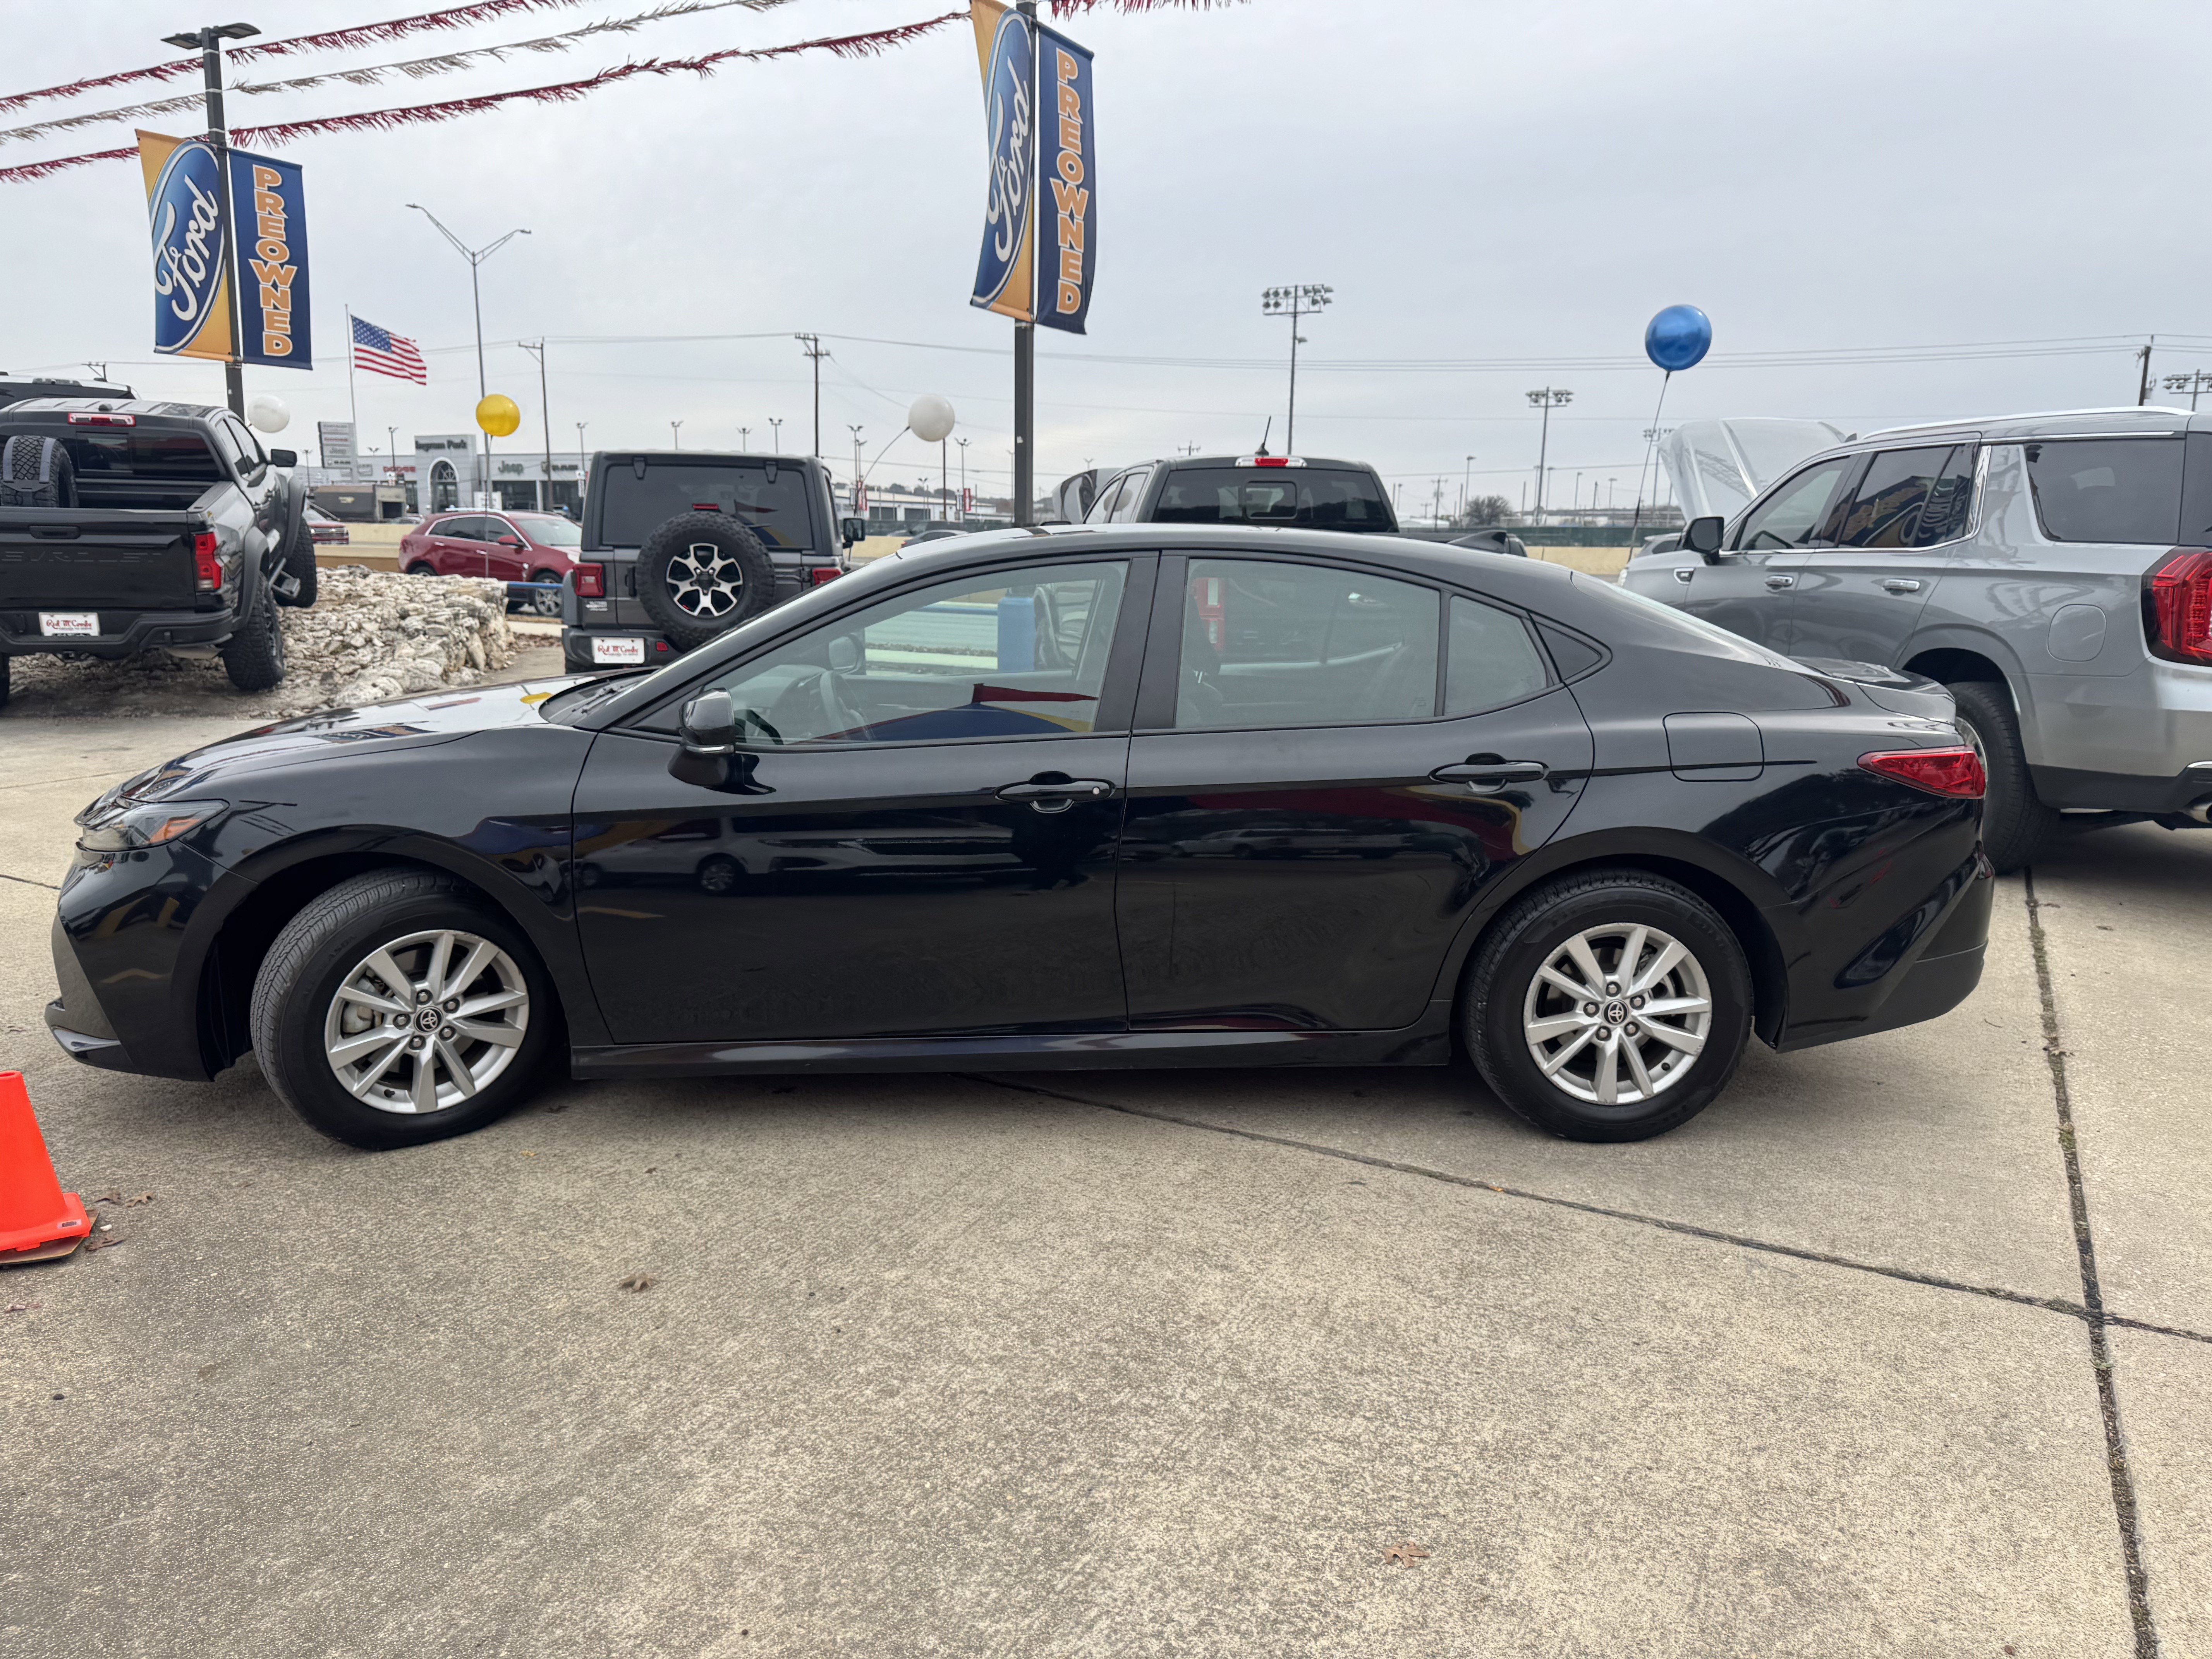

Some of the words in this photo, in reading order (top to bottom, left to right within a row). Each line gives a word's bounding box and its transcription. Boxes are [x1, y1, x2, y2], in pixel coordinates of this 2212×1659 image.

[155, 174, 218, 321] Ford
[987, 55, 1030, 263] Ford
[1049, 47, 1089, 315] PREOWNED
[248, 164, 298, 357] PREOWNED
